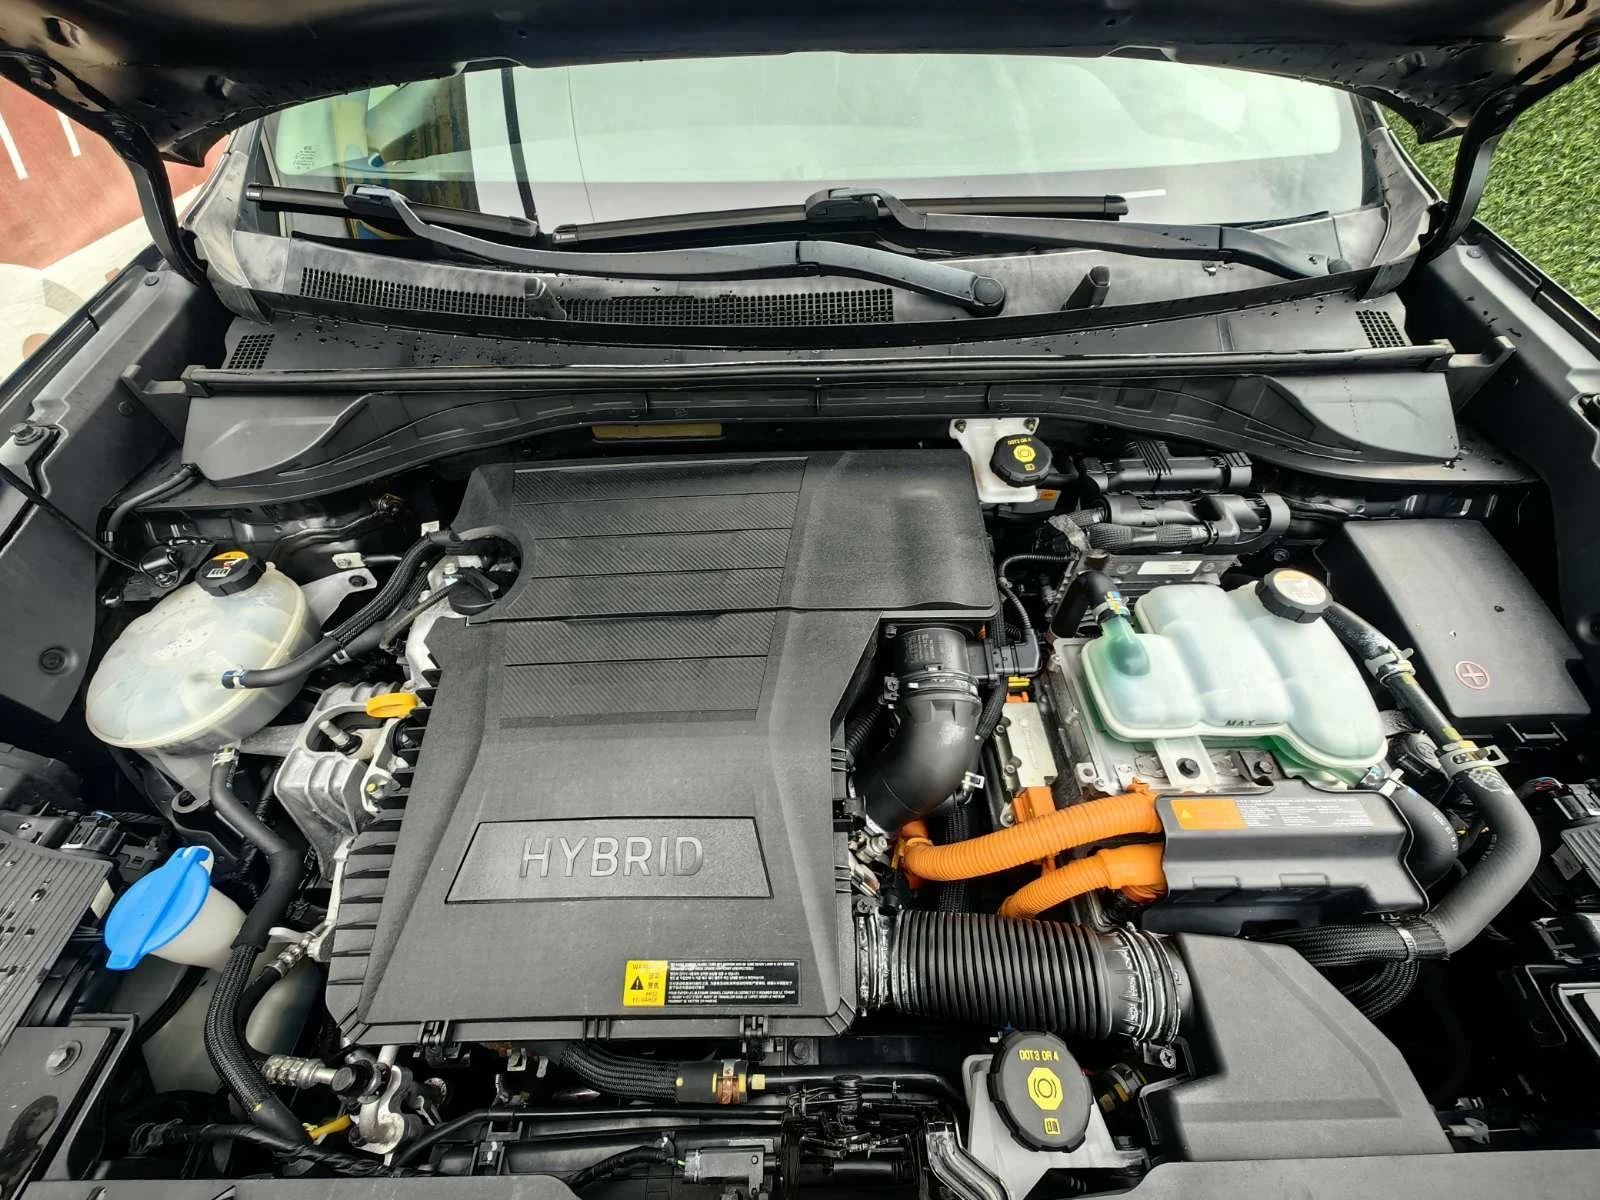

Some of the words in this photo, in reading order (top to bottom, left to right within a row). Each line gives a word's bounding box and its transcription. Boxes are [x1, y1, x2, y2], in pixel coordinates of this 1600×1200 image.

[1224, 719, 1256, 728] MAX
[519, 836, 704, 878] HYBRID
[1041, 1049, 1053, 1061] OR
